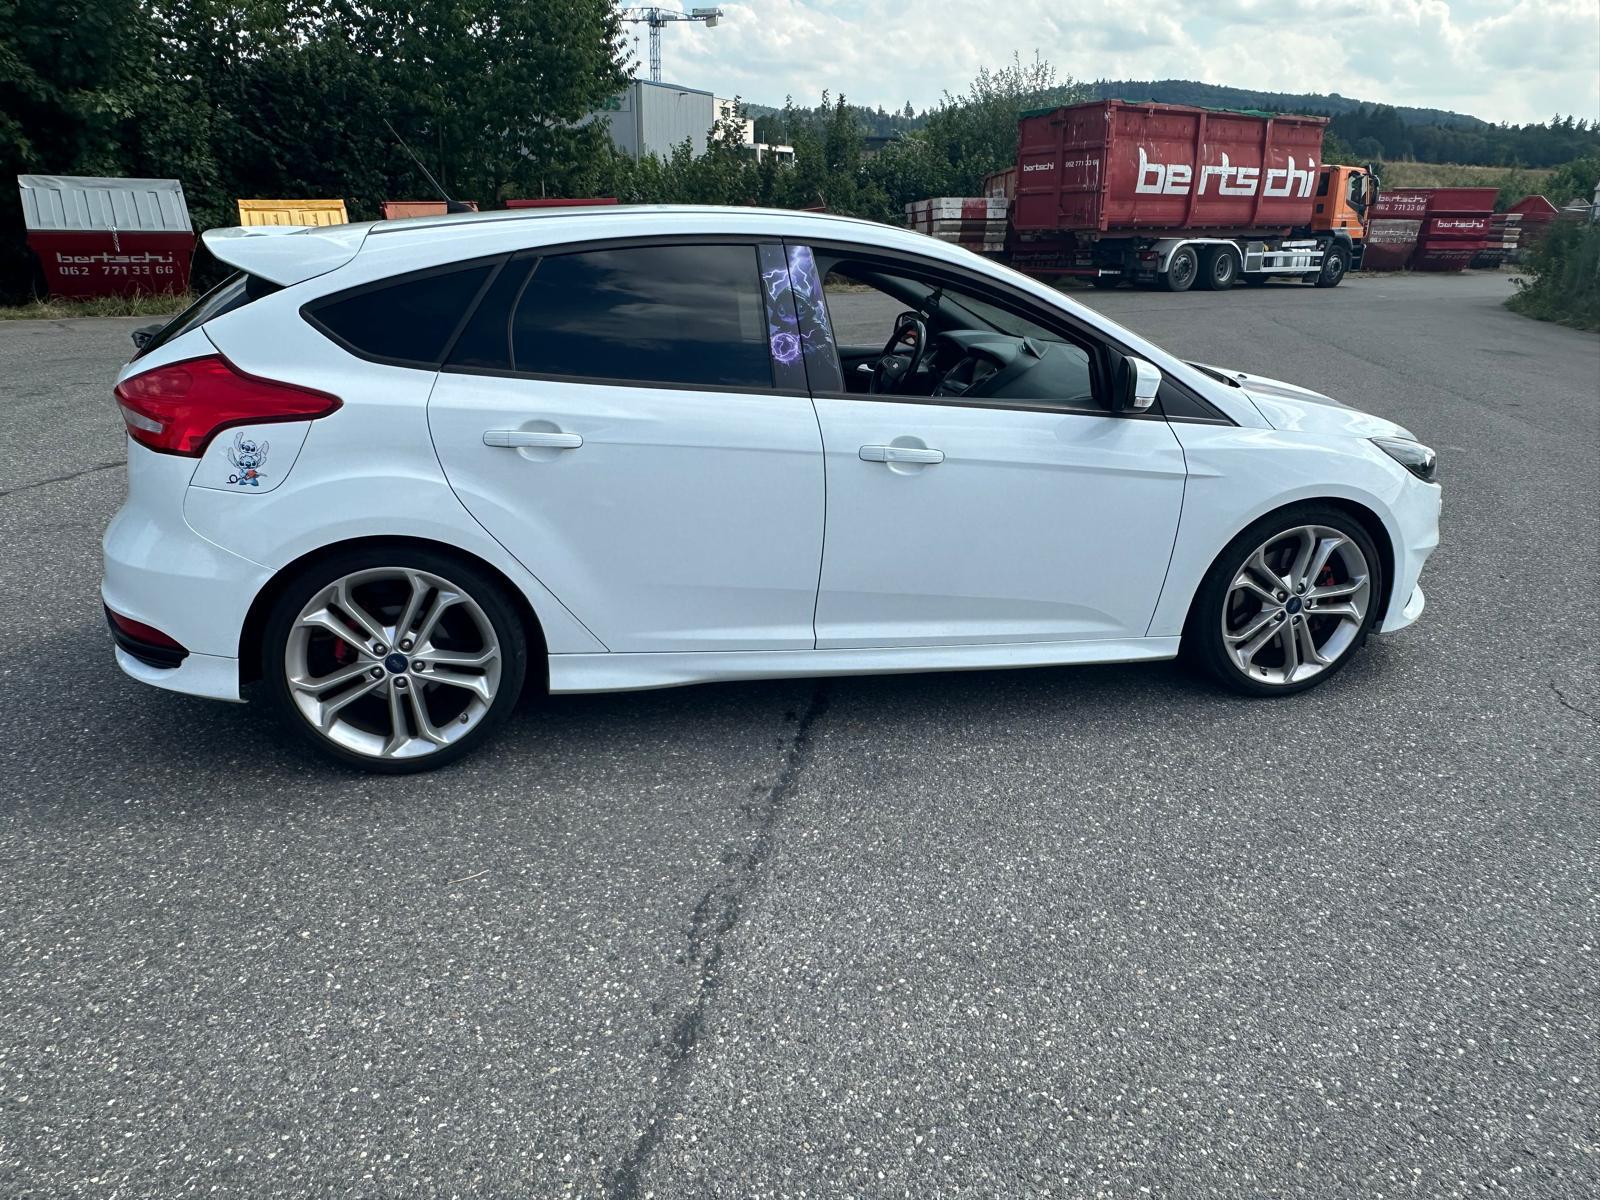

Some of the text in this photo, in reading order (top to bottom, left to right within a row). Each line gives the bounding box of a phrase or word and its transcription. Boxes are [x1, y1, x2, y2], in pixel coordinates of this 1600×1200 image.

[1023, 162, 1054, 171] bertschi
[1135, 147, 1315, 198] bertschi
[1378, 194, 1427, 203] bertschi
[1437, 219, 1485, 228] bertschi
[56, 251, 173, 263] bertschi
[59, 265, 174, 275] 062 771 33 66
